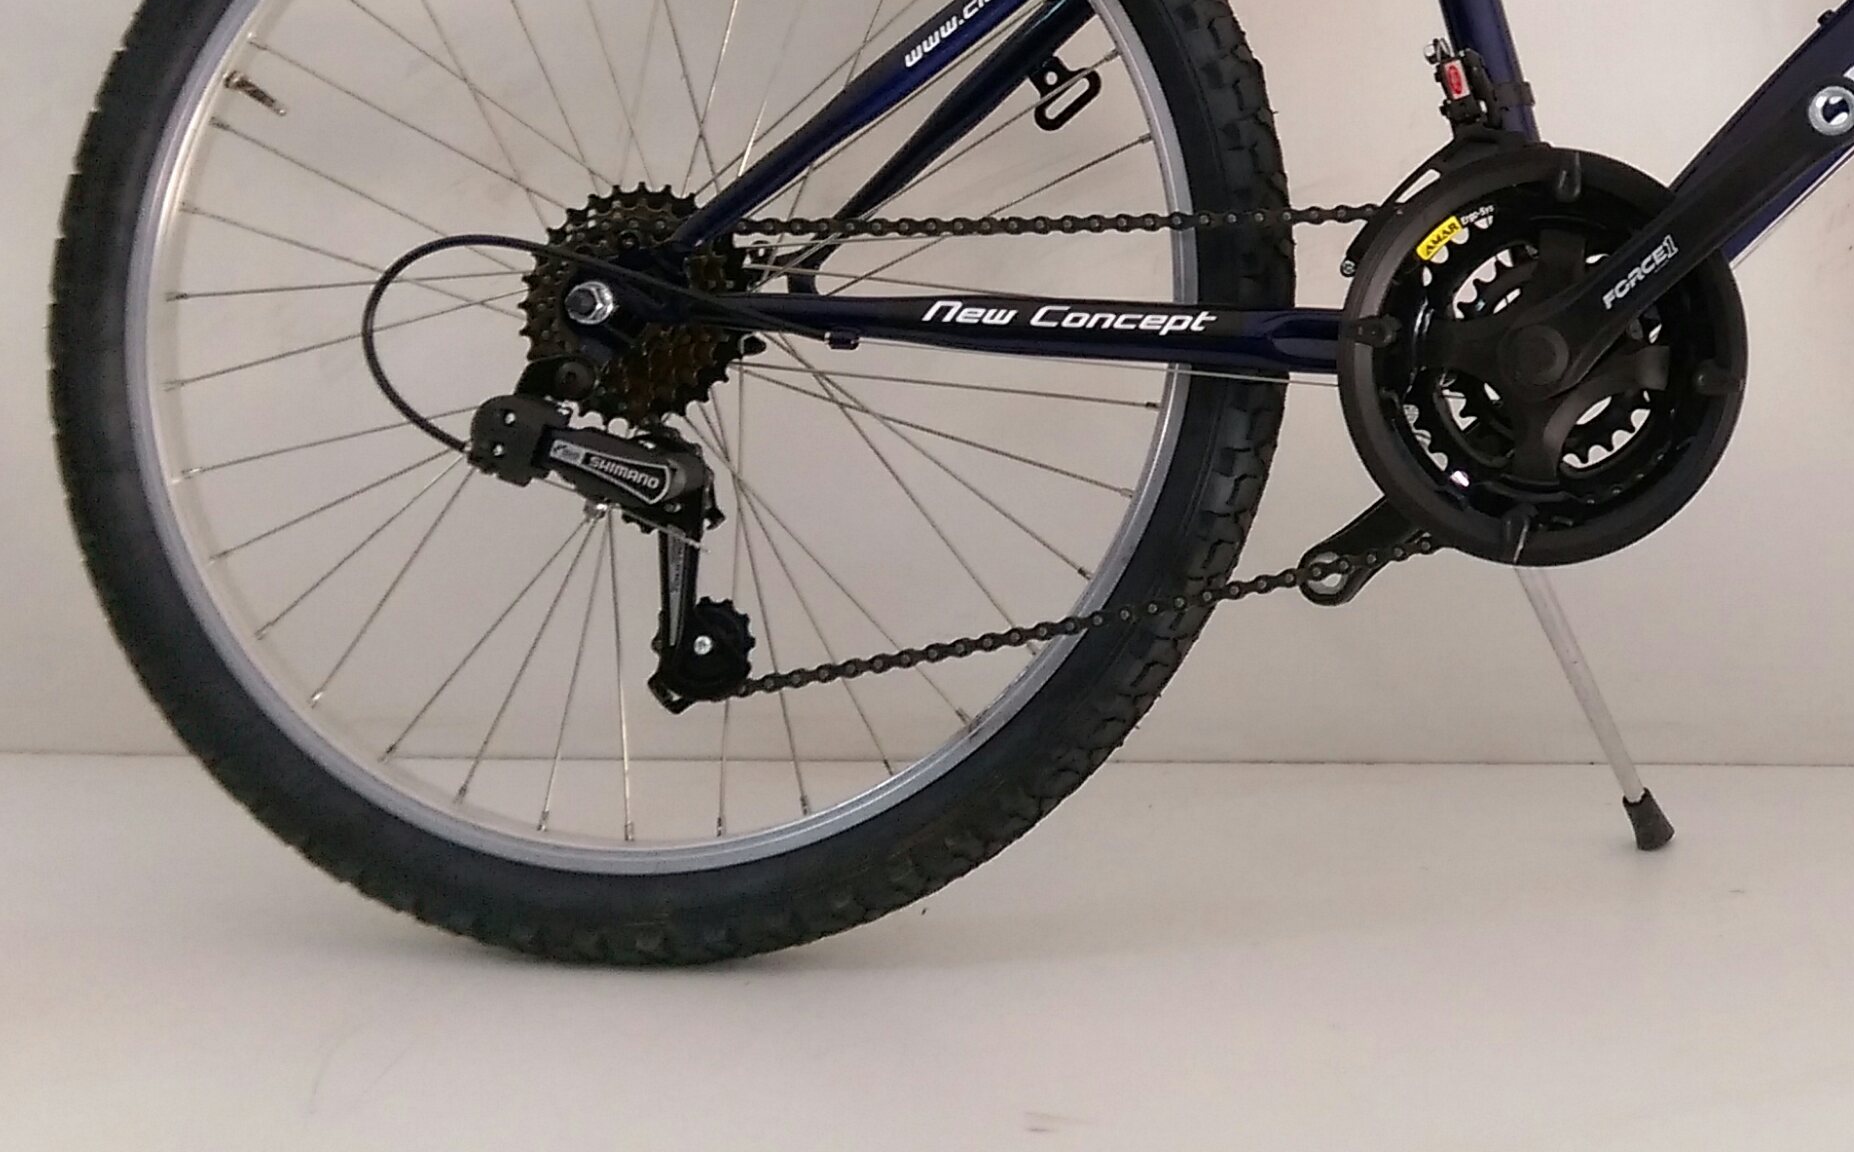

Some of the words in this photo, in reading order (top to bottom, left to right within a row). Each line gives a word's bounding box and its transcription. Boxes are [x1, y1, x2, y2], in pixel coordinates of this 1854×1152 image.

[921, 300, 1019, 327] New
[1029, 304, 1218, 337] Concept
[588, 455, 661, 490] SHIMANO
